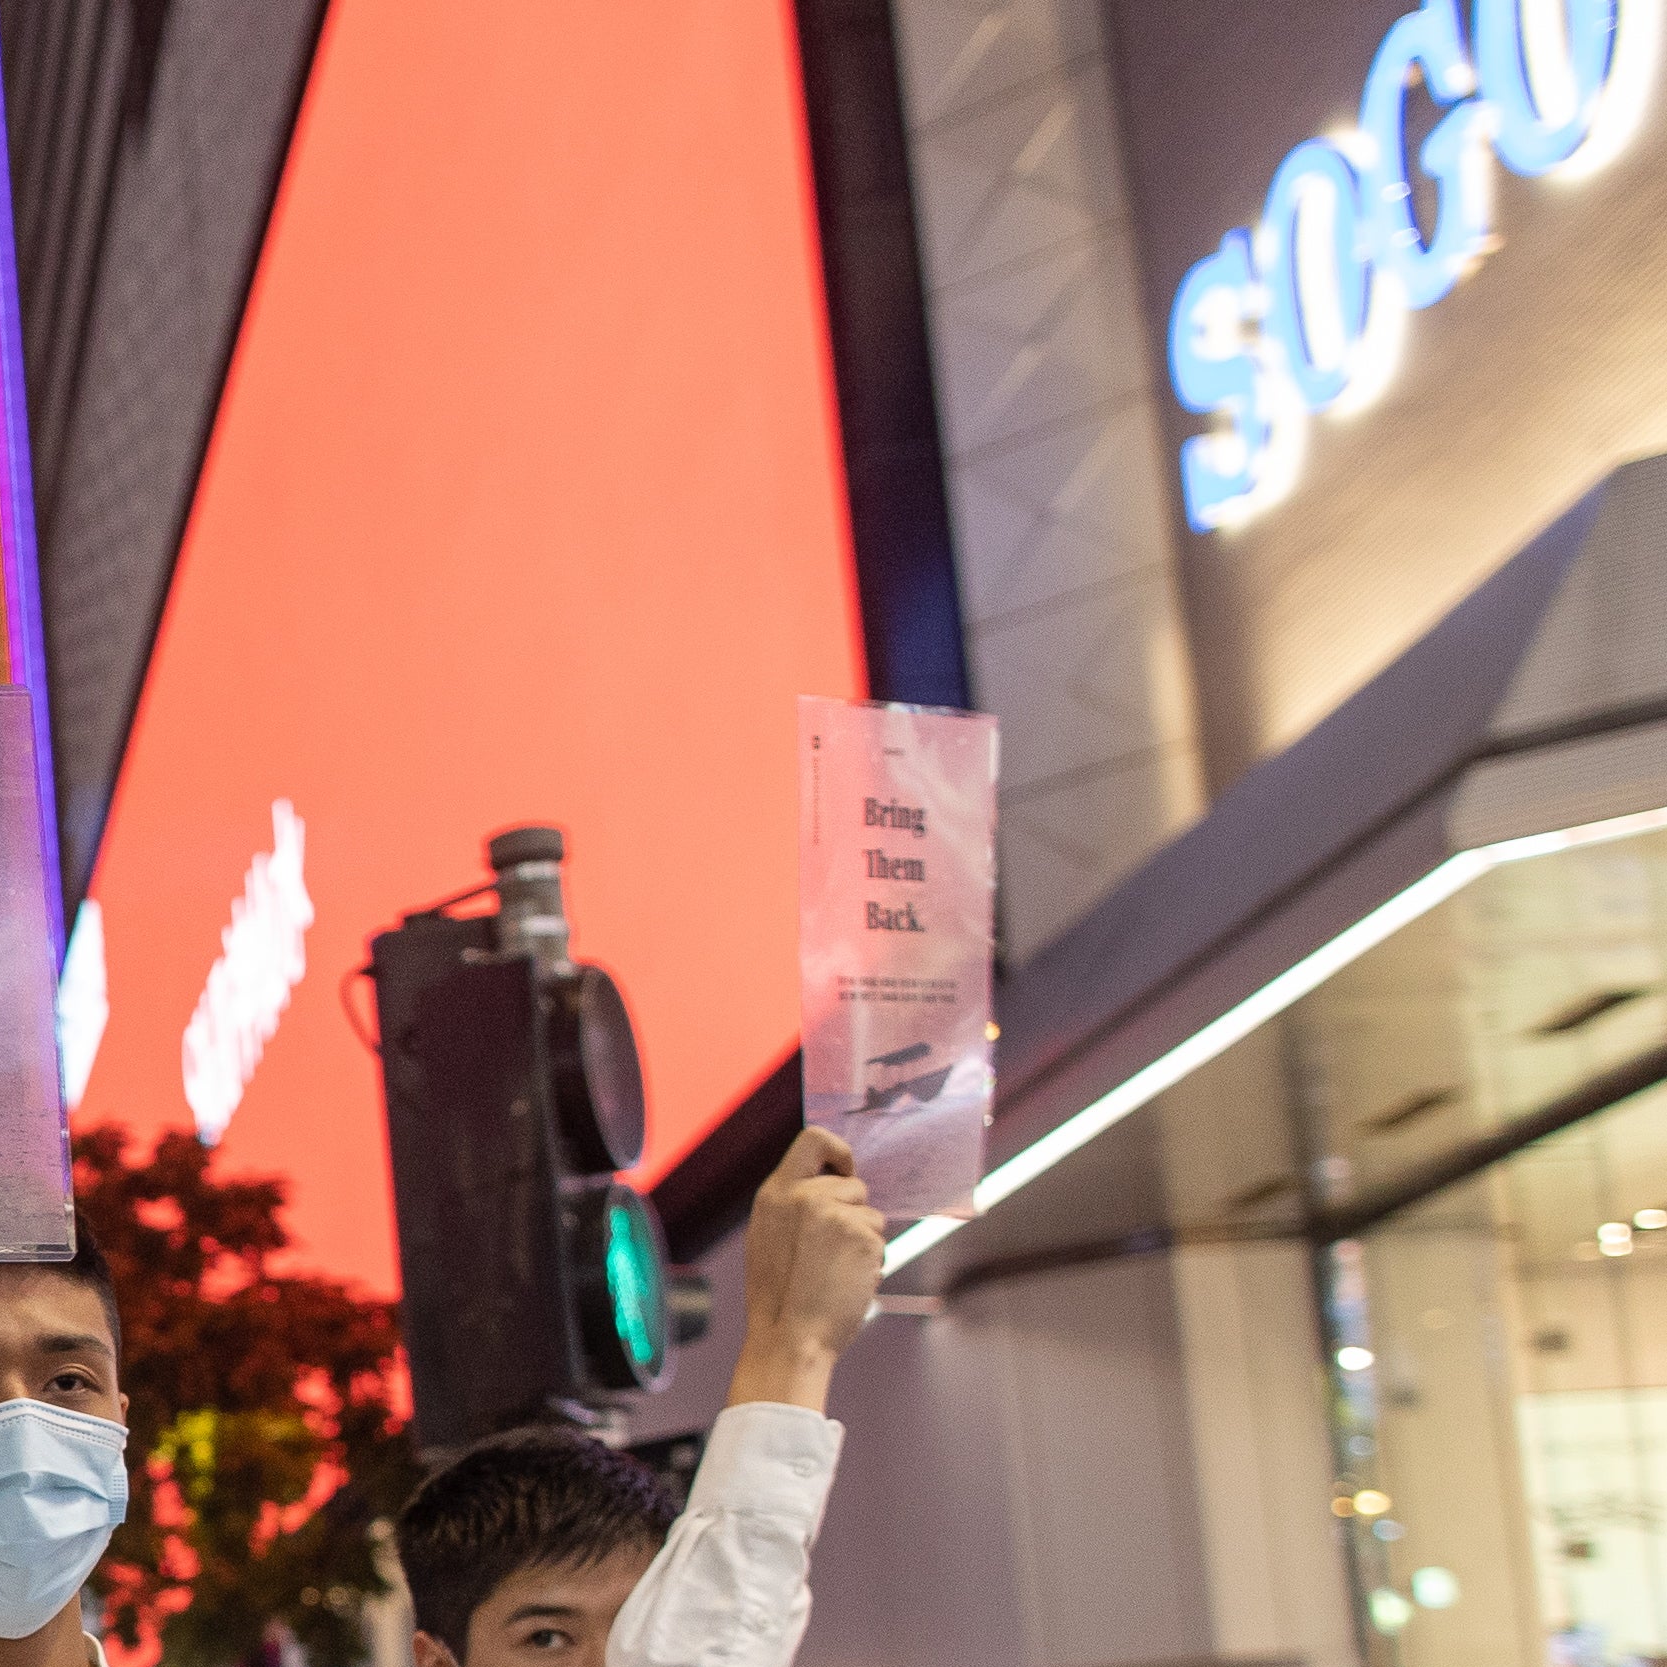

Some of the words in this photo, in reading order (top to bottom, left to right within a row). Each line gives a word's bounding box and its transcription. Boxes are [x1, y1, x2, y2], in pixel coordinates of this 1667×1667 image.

[1168, 0, 1656, 535] SOGO
[864, 796, 926, 835] Bring
[864, 849, 926, 882] Them
[865, 901, 925, 933] Back.
